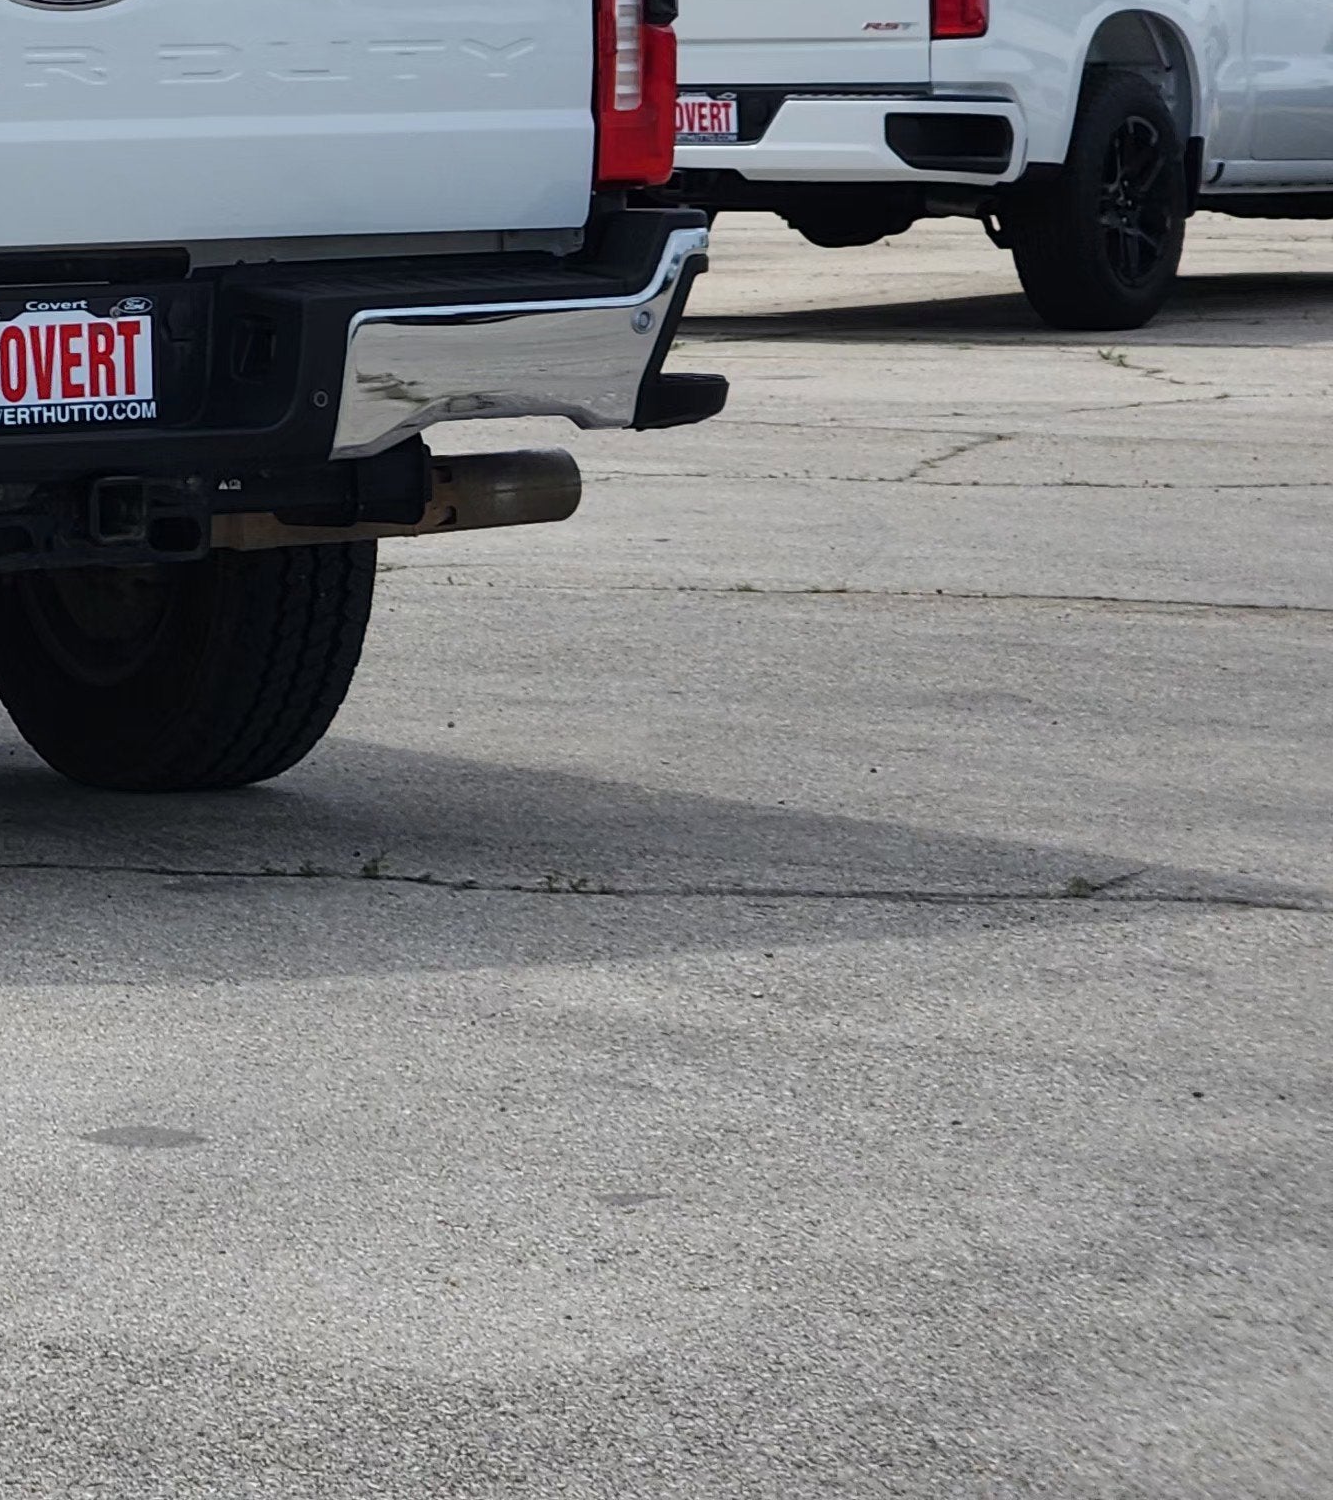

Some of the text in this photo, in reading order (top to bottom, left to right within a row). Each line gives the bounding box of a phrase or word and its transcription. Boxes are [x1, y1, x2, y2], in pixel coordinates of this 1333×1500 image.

[862, 21, 919, 32] RST
[158, 37, 533, 85] DUTY
[674, 102, 732, 132] OVERT
[26, 300, 88, 311] Covert
